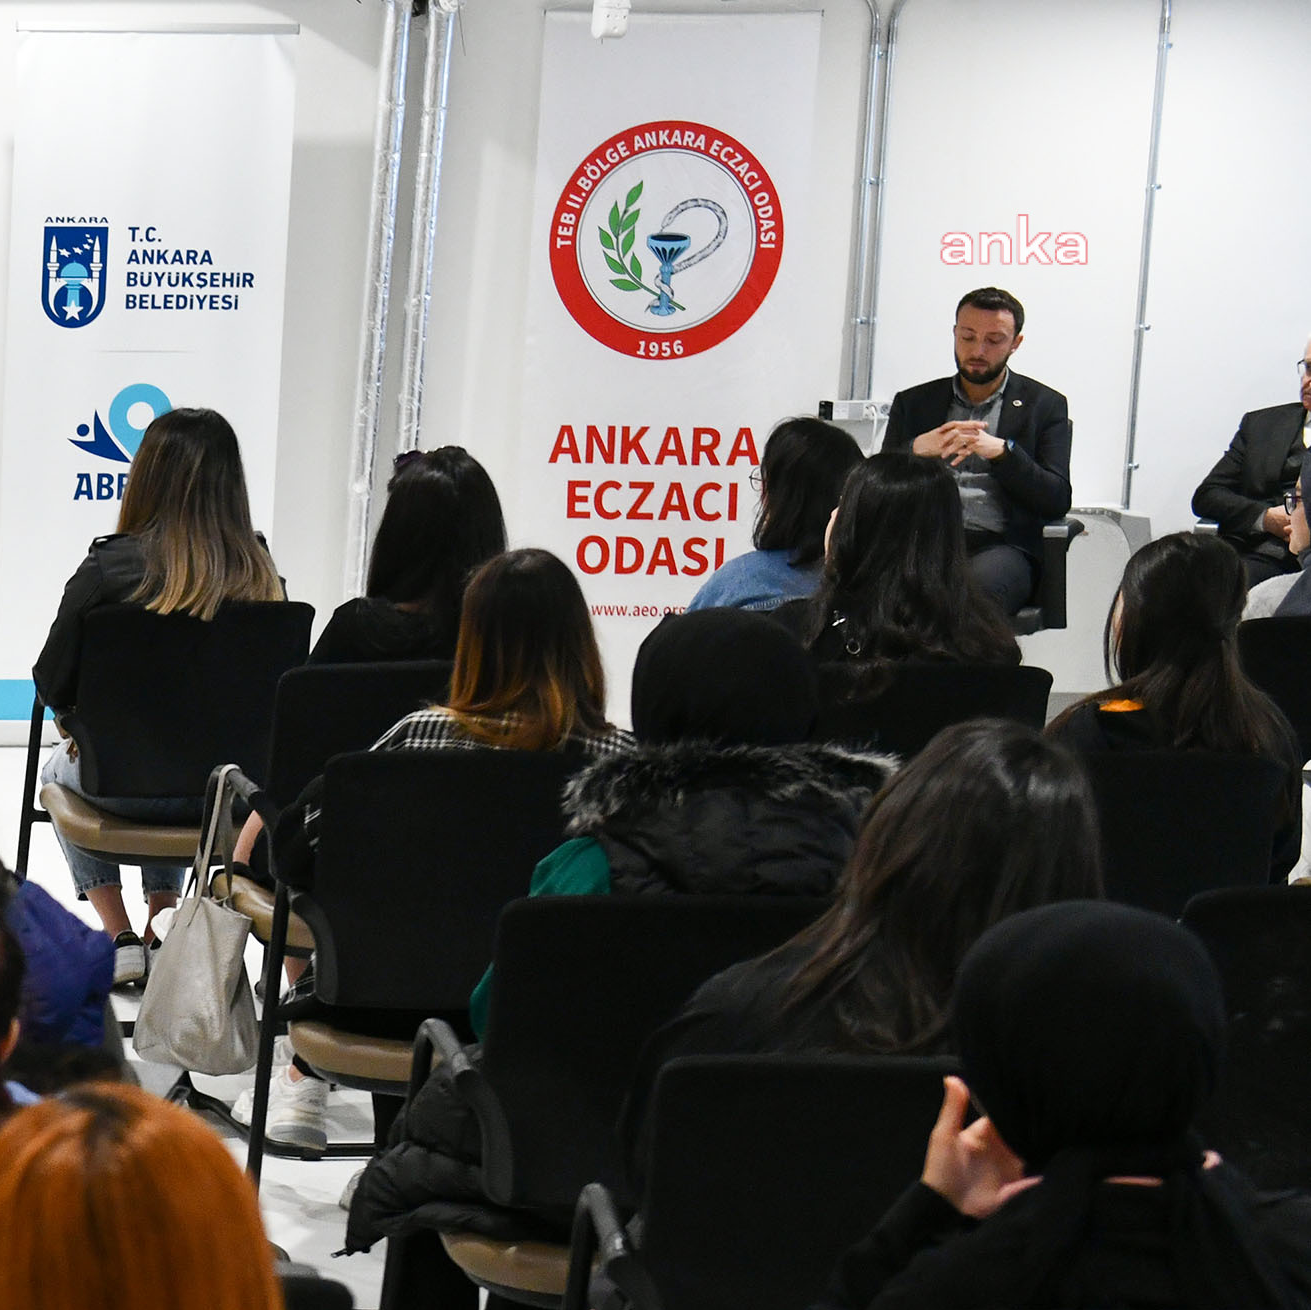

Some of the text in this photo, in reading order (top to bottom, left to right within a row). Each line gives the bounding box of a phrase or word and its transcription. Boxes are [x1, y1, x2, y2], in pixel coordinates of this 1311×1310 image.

[556, 212, 576, 248] TEB
[633, 129, 706, 151] ANKARA
[709, 140, 762, 191] ECZACI
[754, 192, 775, 249] ODASI
[44, 215, 109, 224] ANKARA
[128, 226, 162, 243] T.C.
[127, 249, 213, 266] ANKARA
[636, 340, 684, 357] 1956
[548, 424, 760, 466] ANKARA
[566, 480, 738, 522] ECZACI
[576, 535, 725, 576] ODASI
